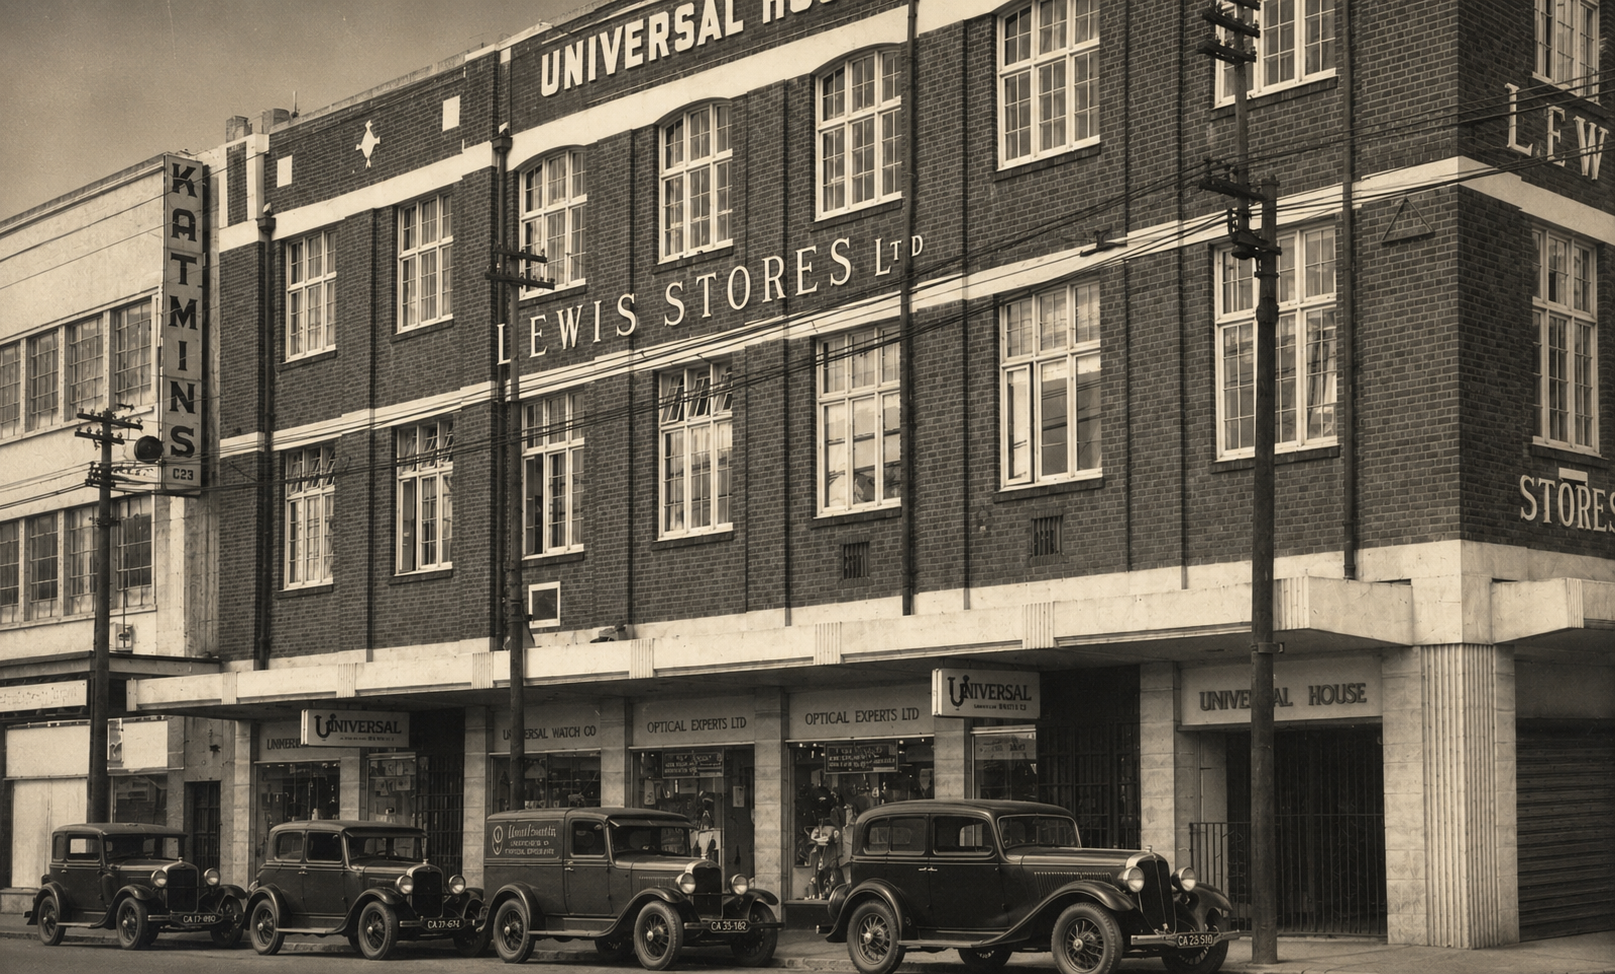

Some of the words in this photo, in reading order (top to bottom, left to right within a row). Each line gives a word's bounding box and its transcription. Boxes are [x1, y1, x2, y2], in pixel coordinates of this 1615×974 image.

[541, 0, 744, 97] UNIVERSAL
[168, 162, 198, 459] KATMINS
[497, 293, 637, 365] LEWIS
[664, 237, 852, 326] STORES
[172, 468, 194, 481] C23
[947, 675, 1032, 707] UNIVERSAL
[1199, 687, 1294, 711] UNIVEAL
[1308, 682, 1368, 706] HOUSE
[314, 713, 402, 738] UNIVERSAL
[647, 720, 687, 733] OPTICAL
[691, 718, 728, 731] EXPERTS
[731, 716, 747, 729] LTD
[805, 711, 850, 725] OPTICAL
[855, 708, 898, 723] EXPERTS
[902, 707, 920, 720] LTD
[503, 727, 549, 740] UNERSAL
[552, 726, 581, 738] WATCH
[583, 724, 597, 737] CO
[1178, 935, 1188, 946] CA
